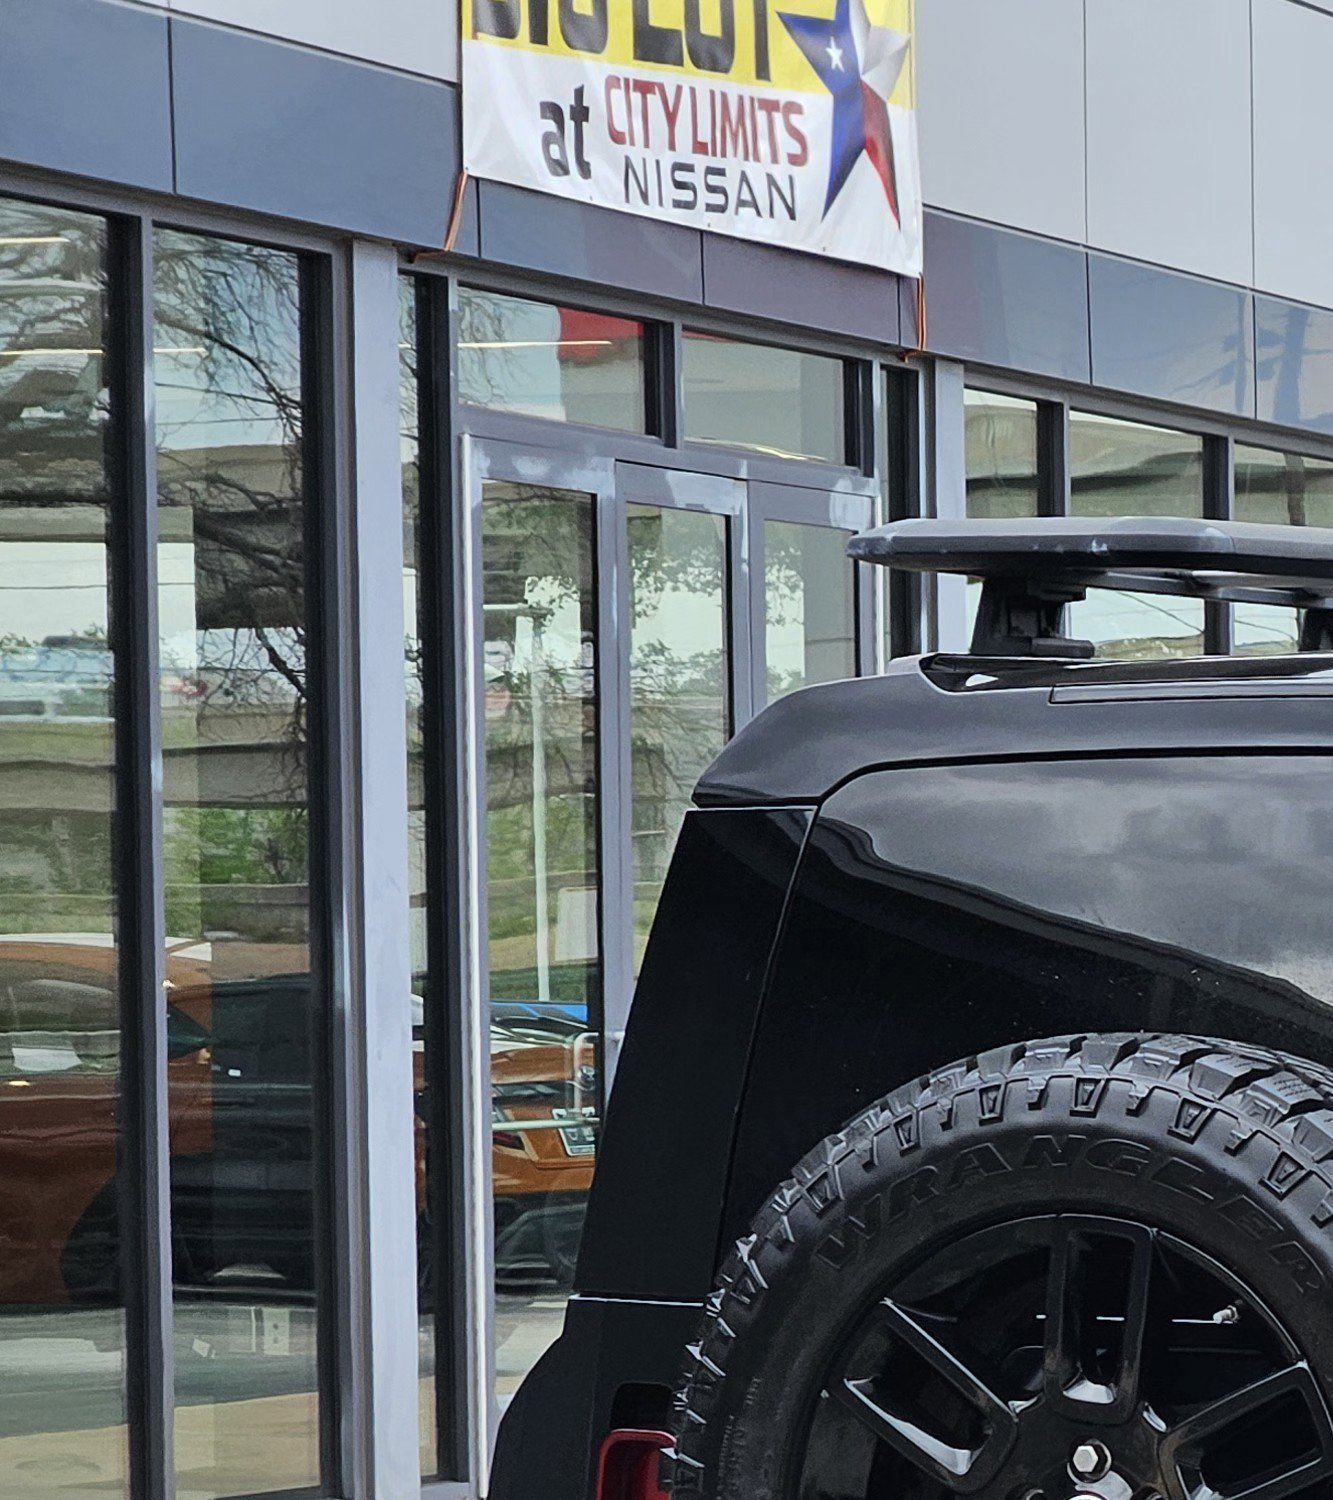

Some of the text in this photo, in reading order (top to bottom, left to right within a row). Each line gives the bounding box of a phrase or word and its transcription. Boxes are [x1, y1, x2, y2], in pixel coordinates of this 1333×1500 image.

[540, 83, 591, 180] at
[604, 75, 810, 167] CITY LIMITS
[624, 155, 797, 220] NISSAN
[812, 1133, 1331, 1296] WRANGLER
